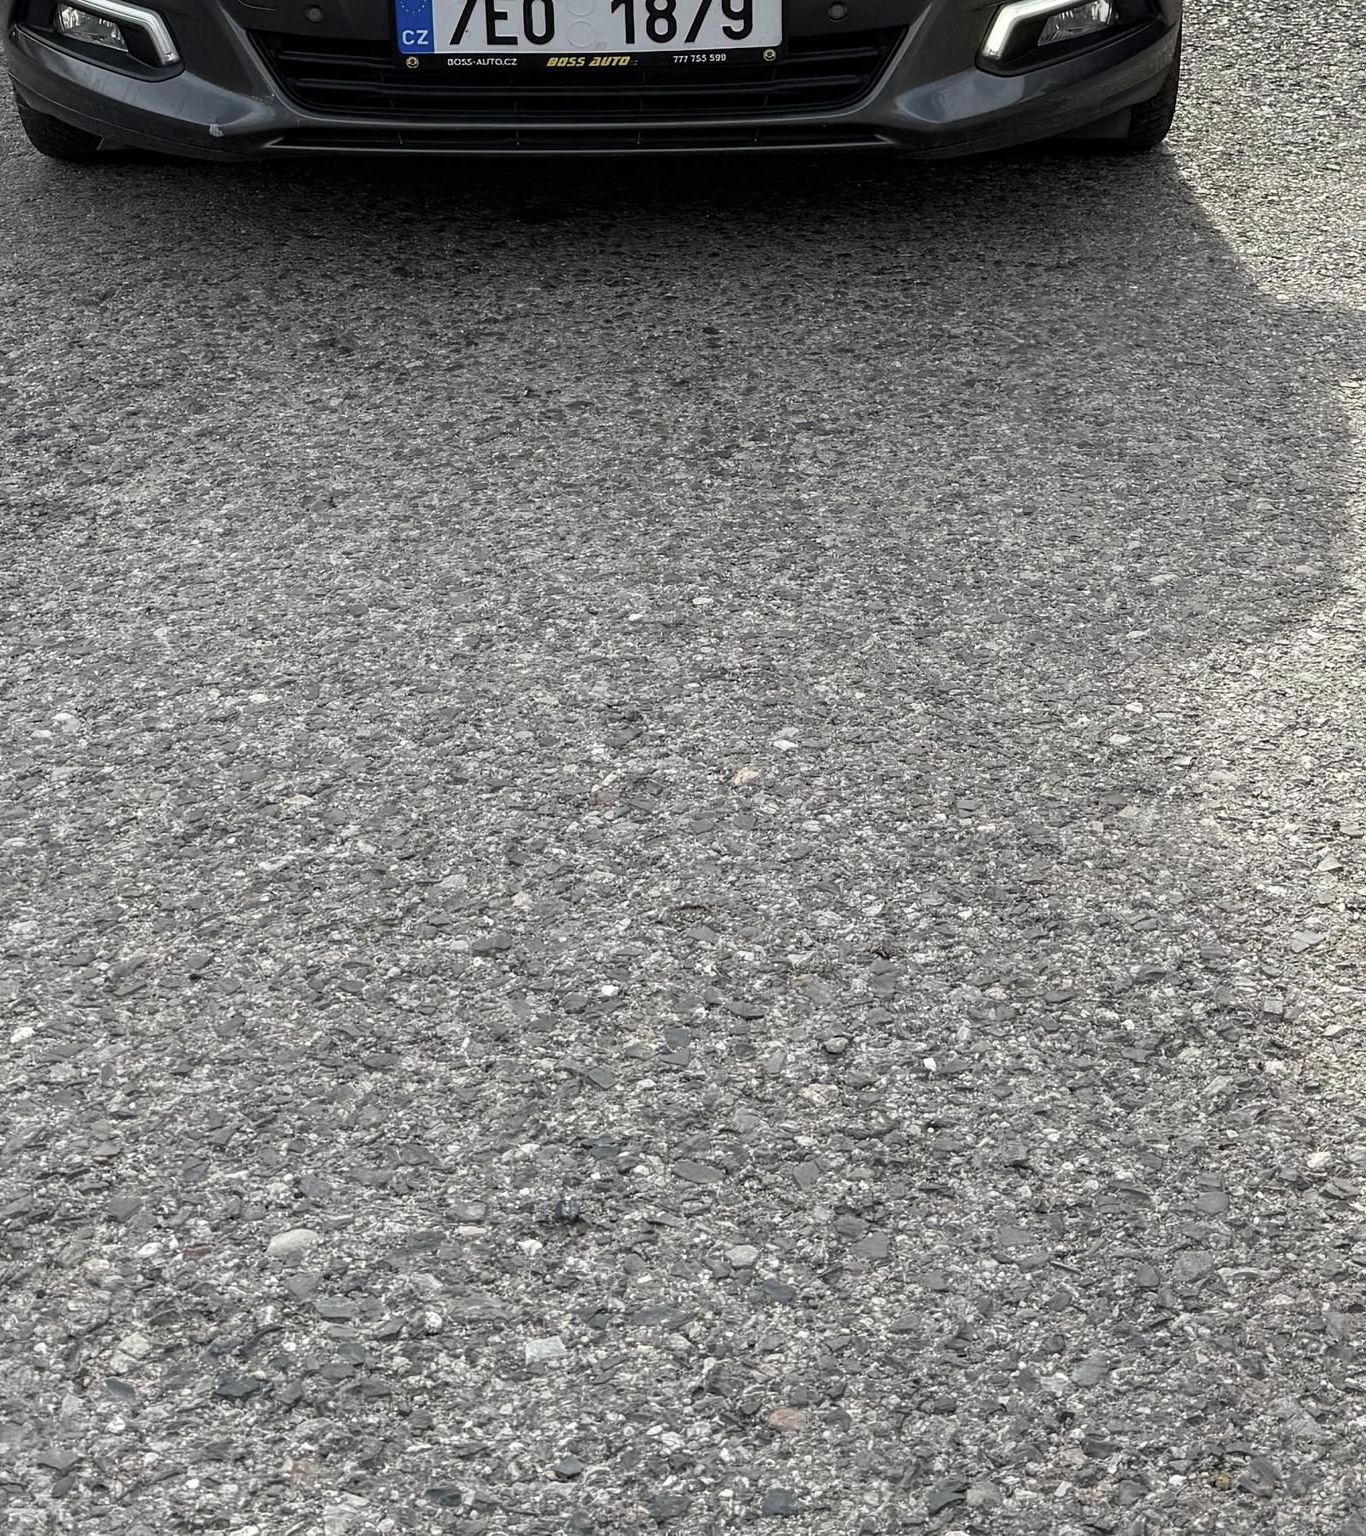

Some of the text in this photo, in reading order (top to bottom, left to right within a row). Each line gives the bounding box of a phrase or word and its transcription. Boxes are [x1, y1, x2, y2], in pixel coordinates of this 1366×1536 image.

[402, 29, 429, 45] CZ
[447, 58, 518, 66] BOSS-AUTO.CZ
[546, 57, 585, 67] BOSS
[588, 55, 631, 66] AUTO
